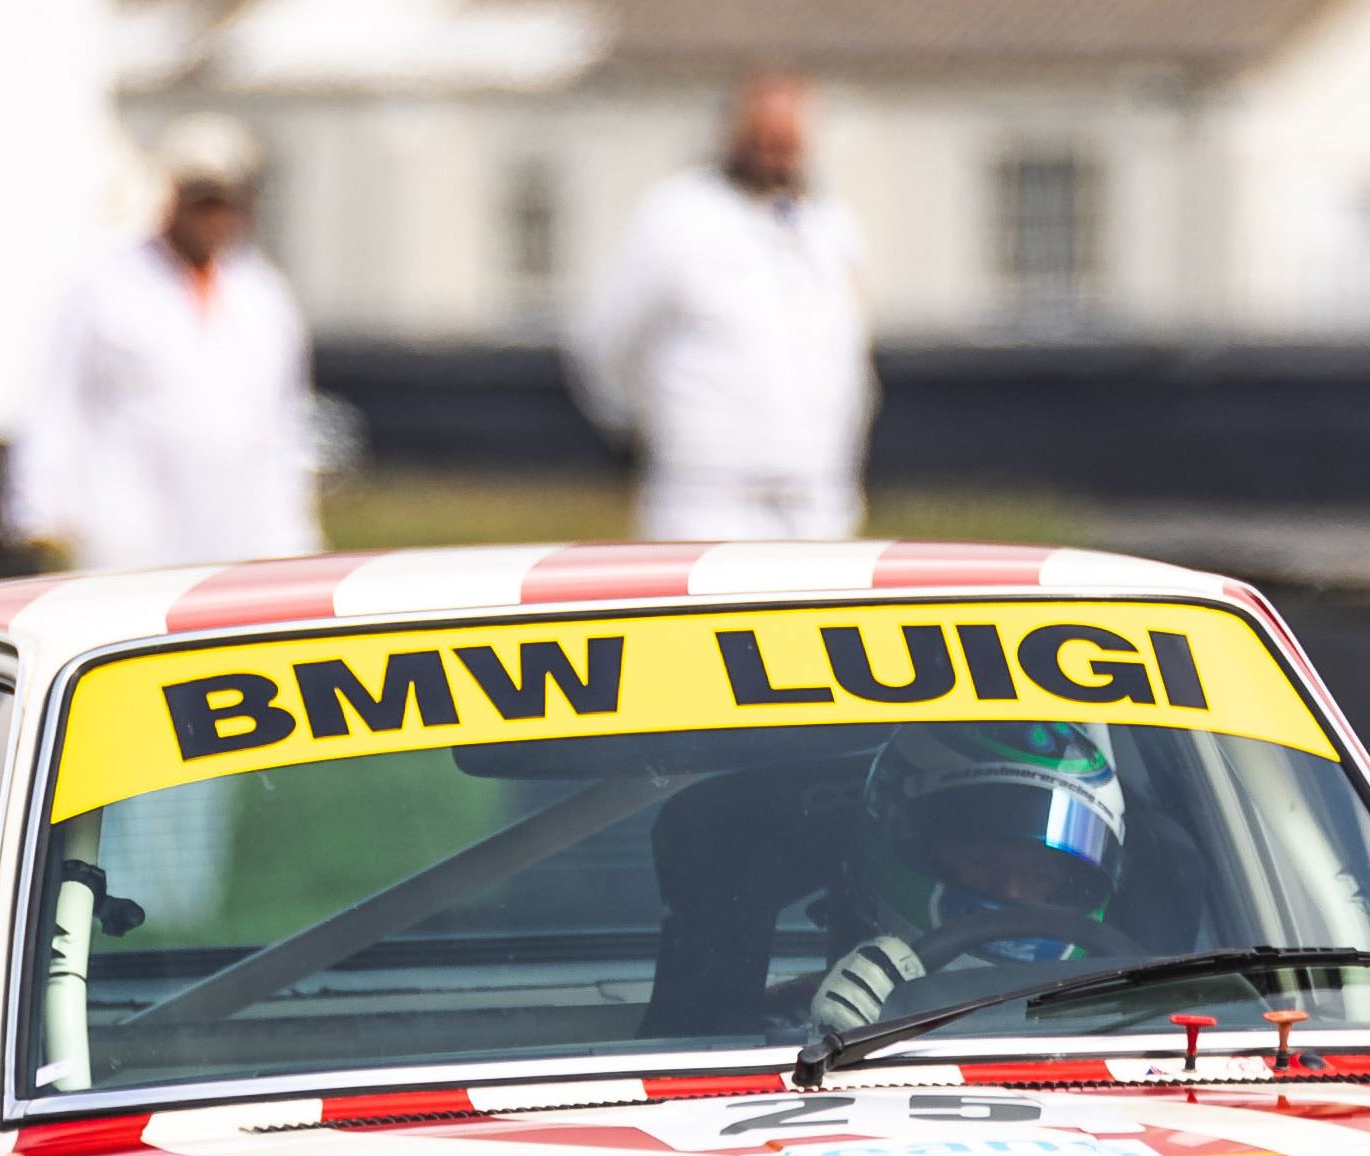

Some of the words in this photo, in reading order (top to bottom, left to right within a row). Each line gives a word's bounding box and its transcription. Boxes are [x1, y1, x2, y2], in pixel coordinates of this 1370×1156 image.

[162, 636, 626, 762] BMW
[715, 623, 1209, 712] LUIGI
[720, 1092, 1042, 1136] 25
